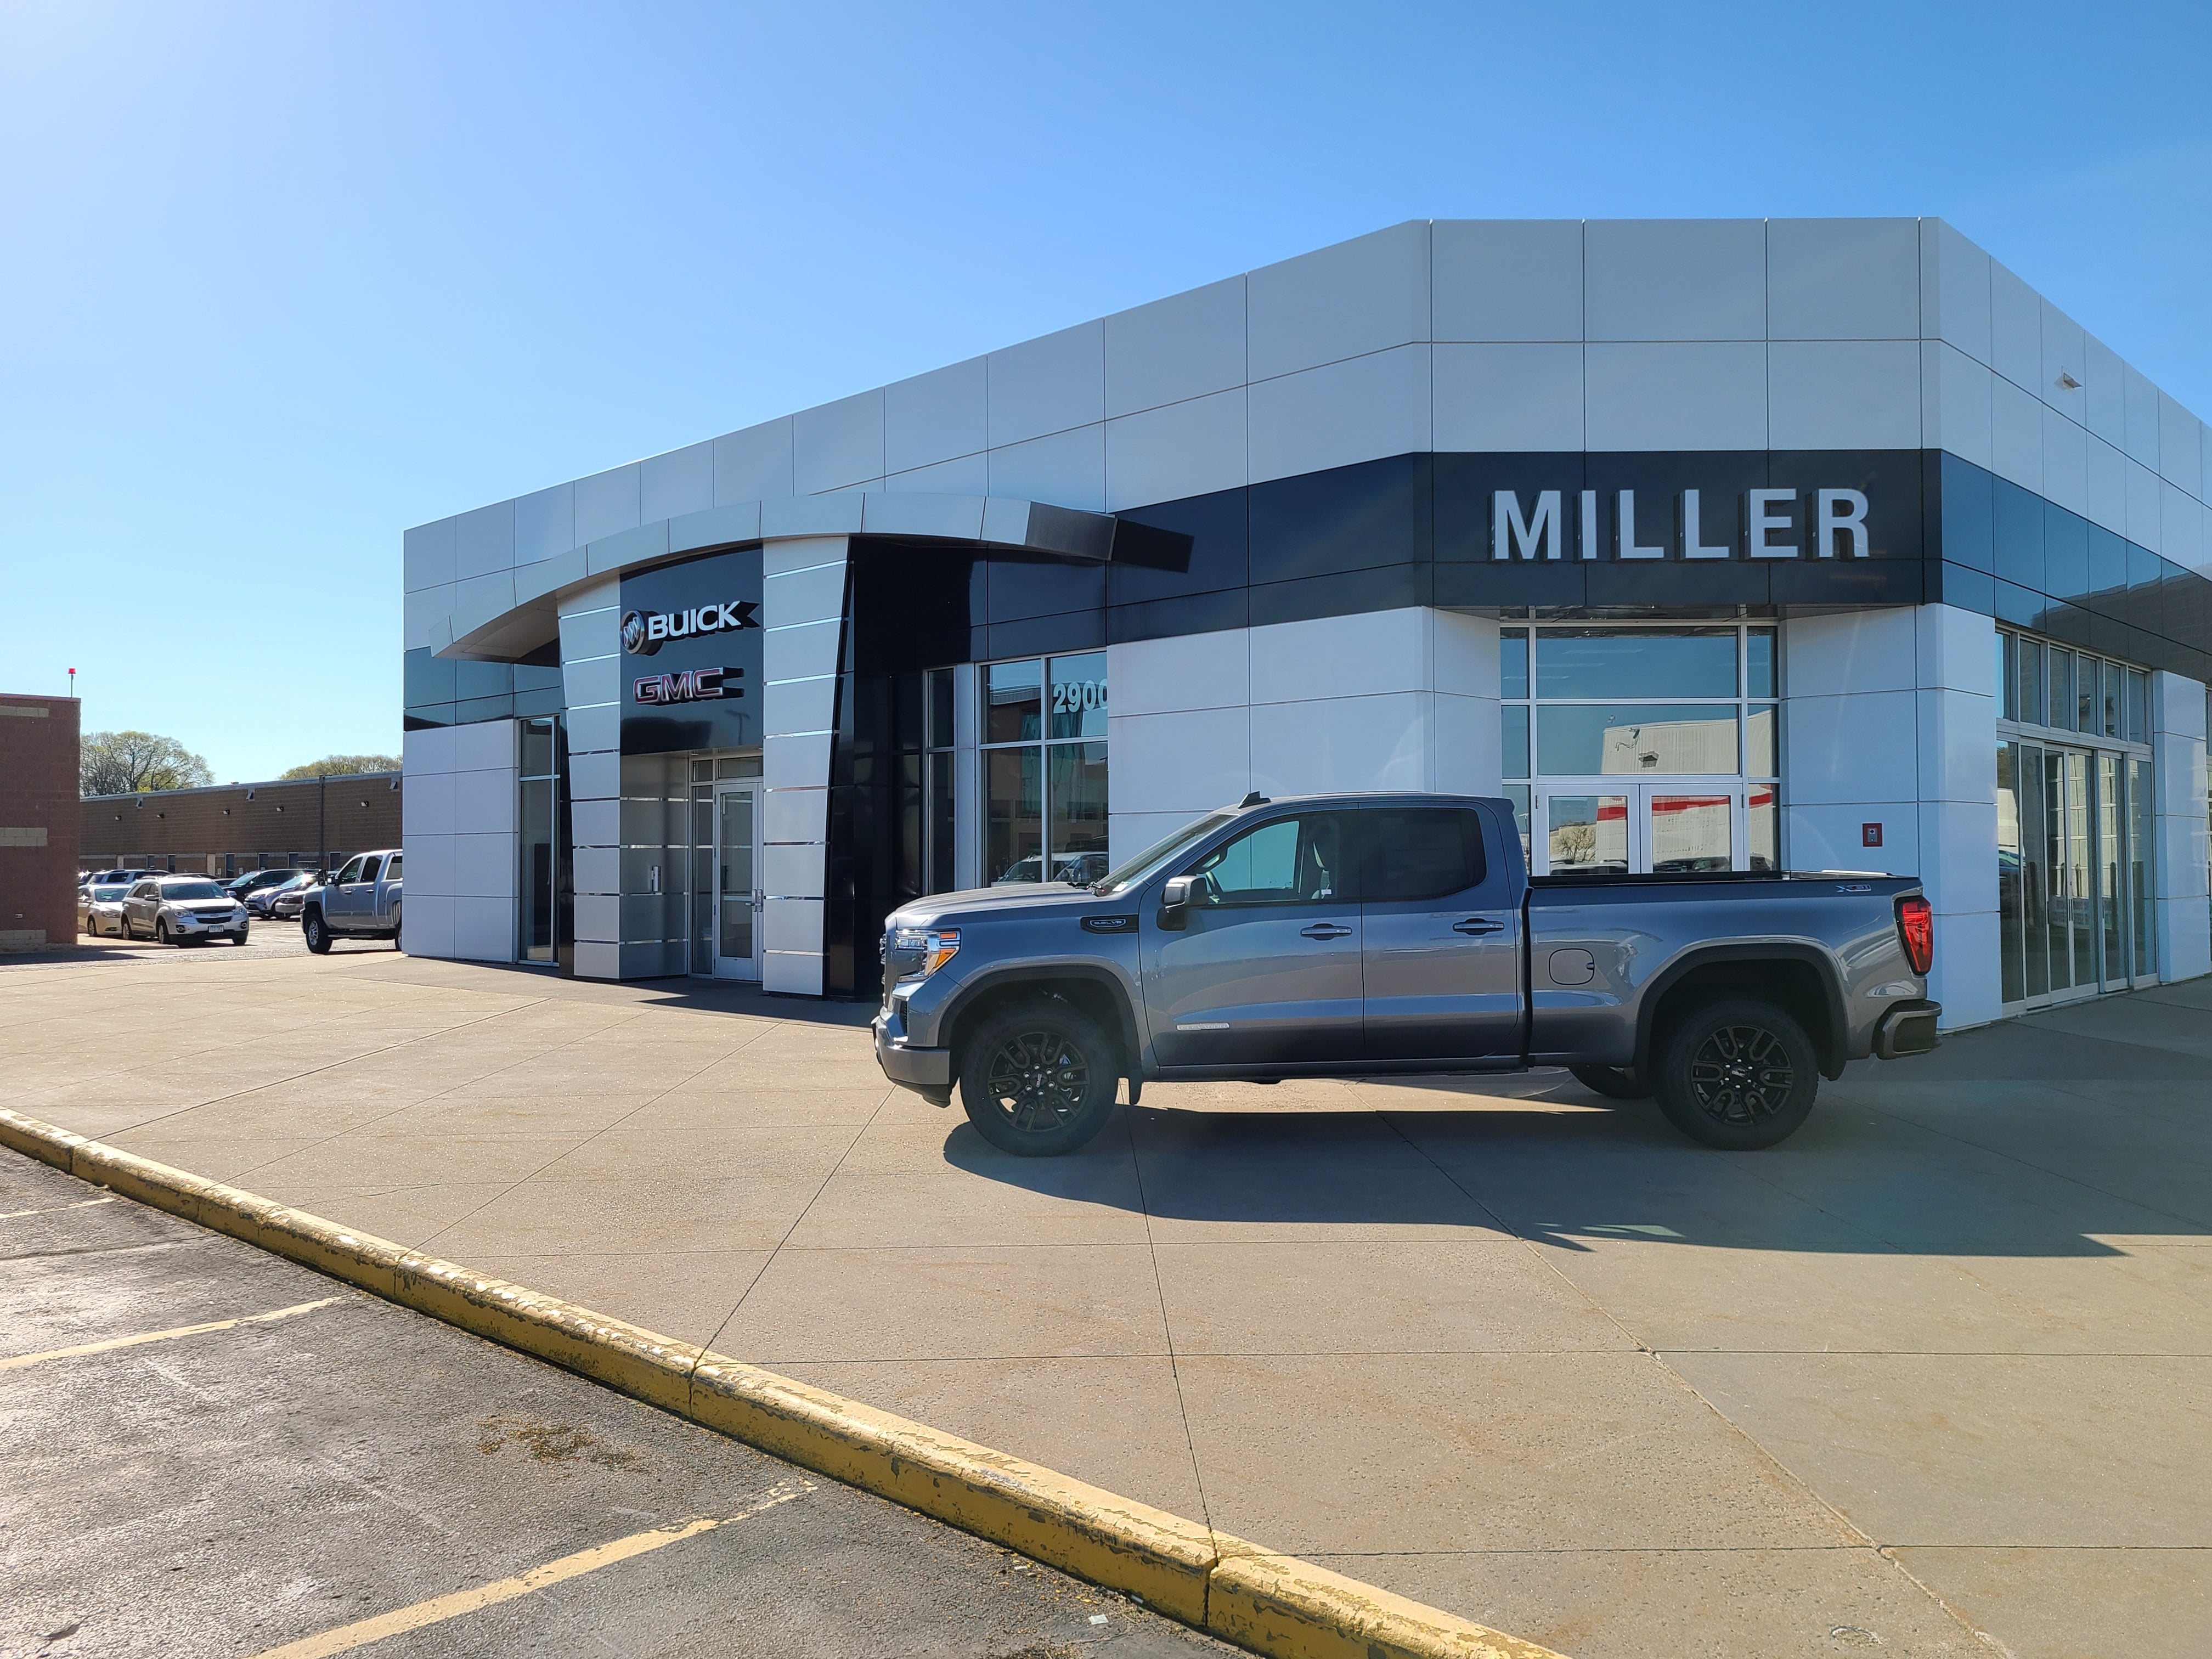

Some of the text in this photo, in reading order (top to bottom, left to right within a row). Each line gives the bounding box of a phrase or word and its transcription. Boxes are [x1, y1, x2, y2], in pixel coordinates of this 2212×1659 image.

[1492, 488, 1870, 560] MILLER
[648, 601, 741, 640] BUICK
[633, 667, 723, 704] GMC
[1053, 678, 1108, 714] 2900
